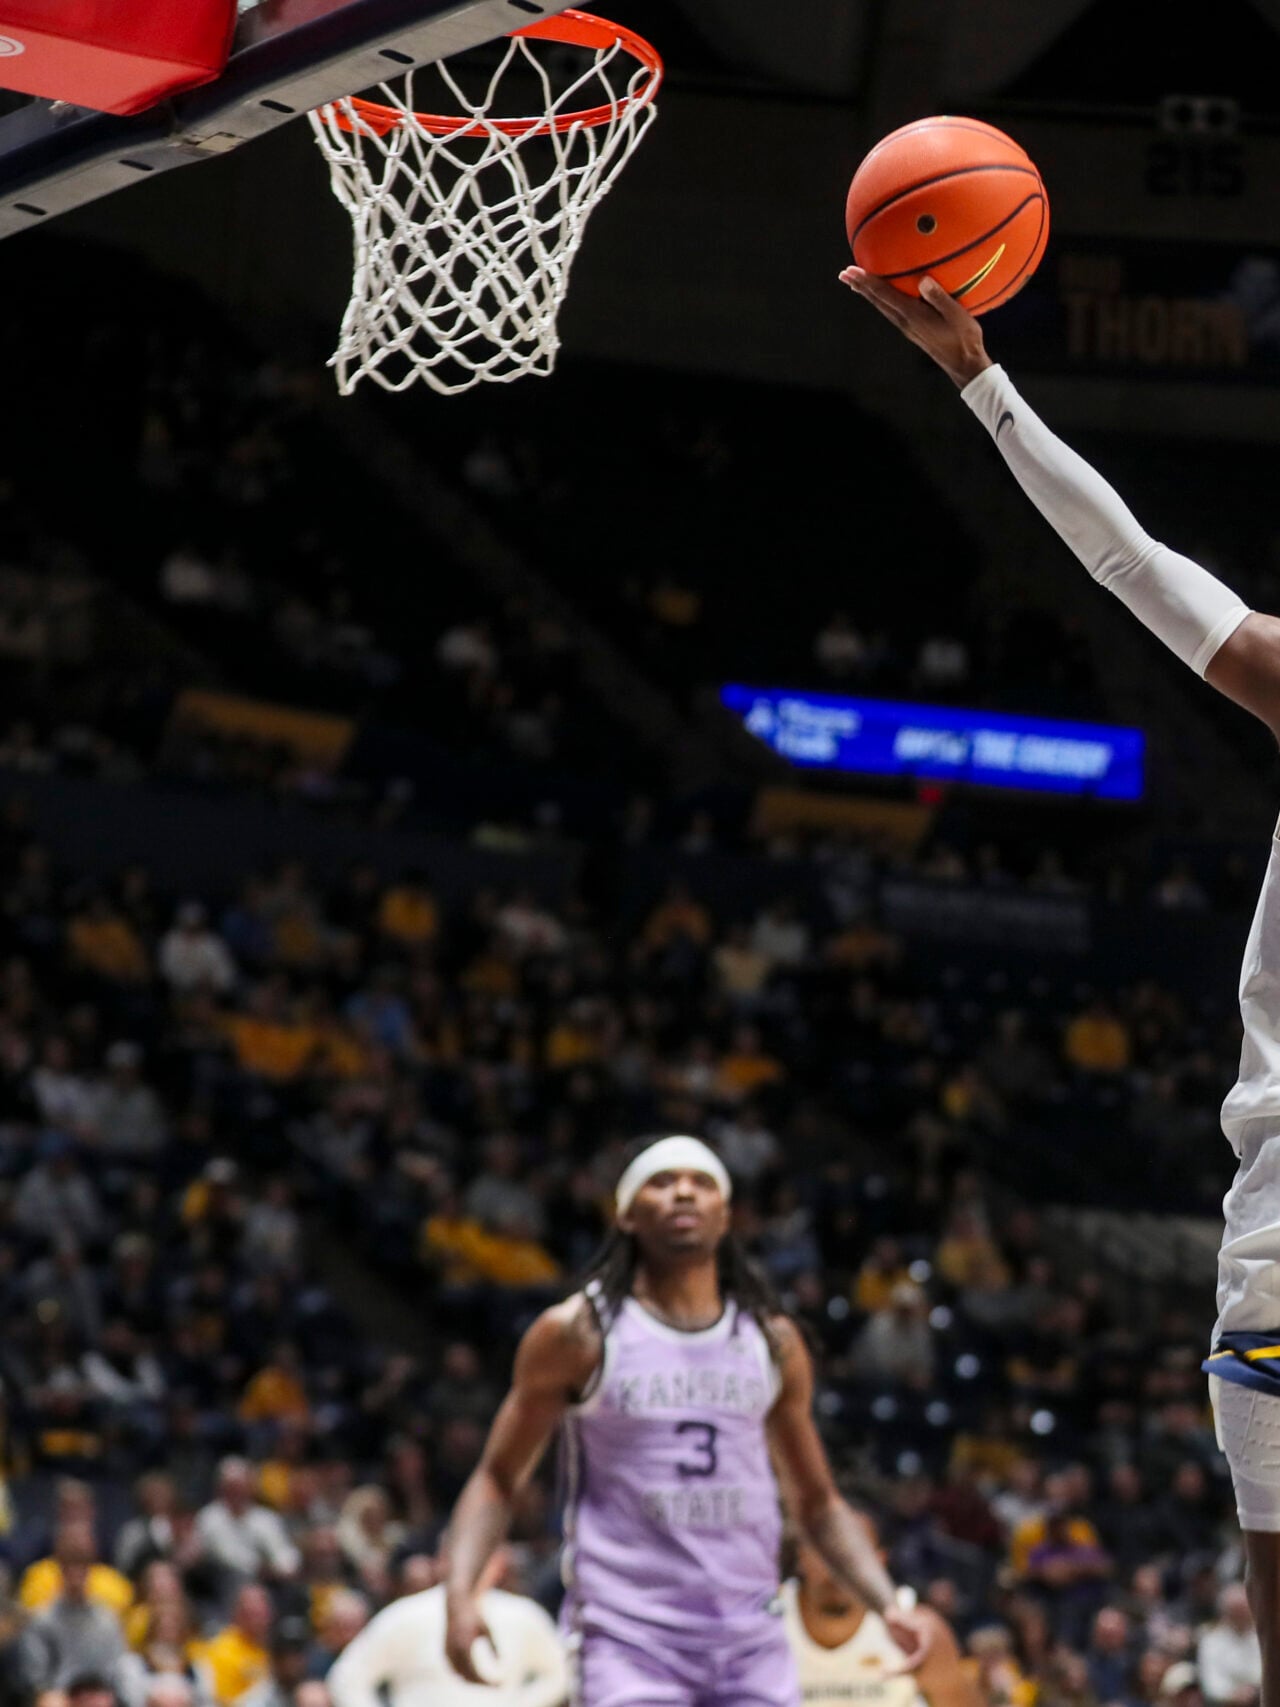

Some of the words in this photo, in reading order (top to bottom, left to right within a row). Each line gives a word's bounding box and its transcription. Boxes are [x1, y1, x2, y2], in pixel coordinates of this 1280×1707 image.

[1144, 143, 1245, 197] 215
[1065, 294, 1249, 367] THORN
[618, 1370, 766, 1415] KANSAS
[674, 1420, 719, 1478] 3
